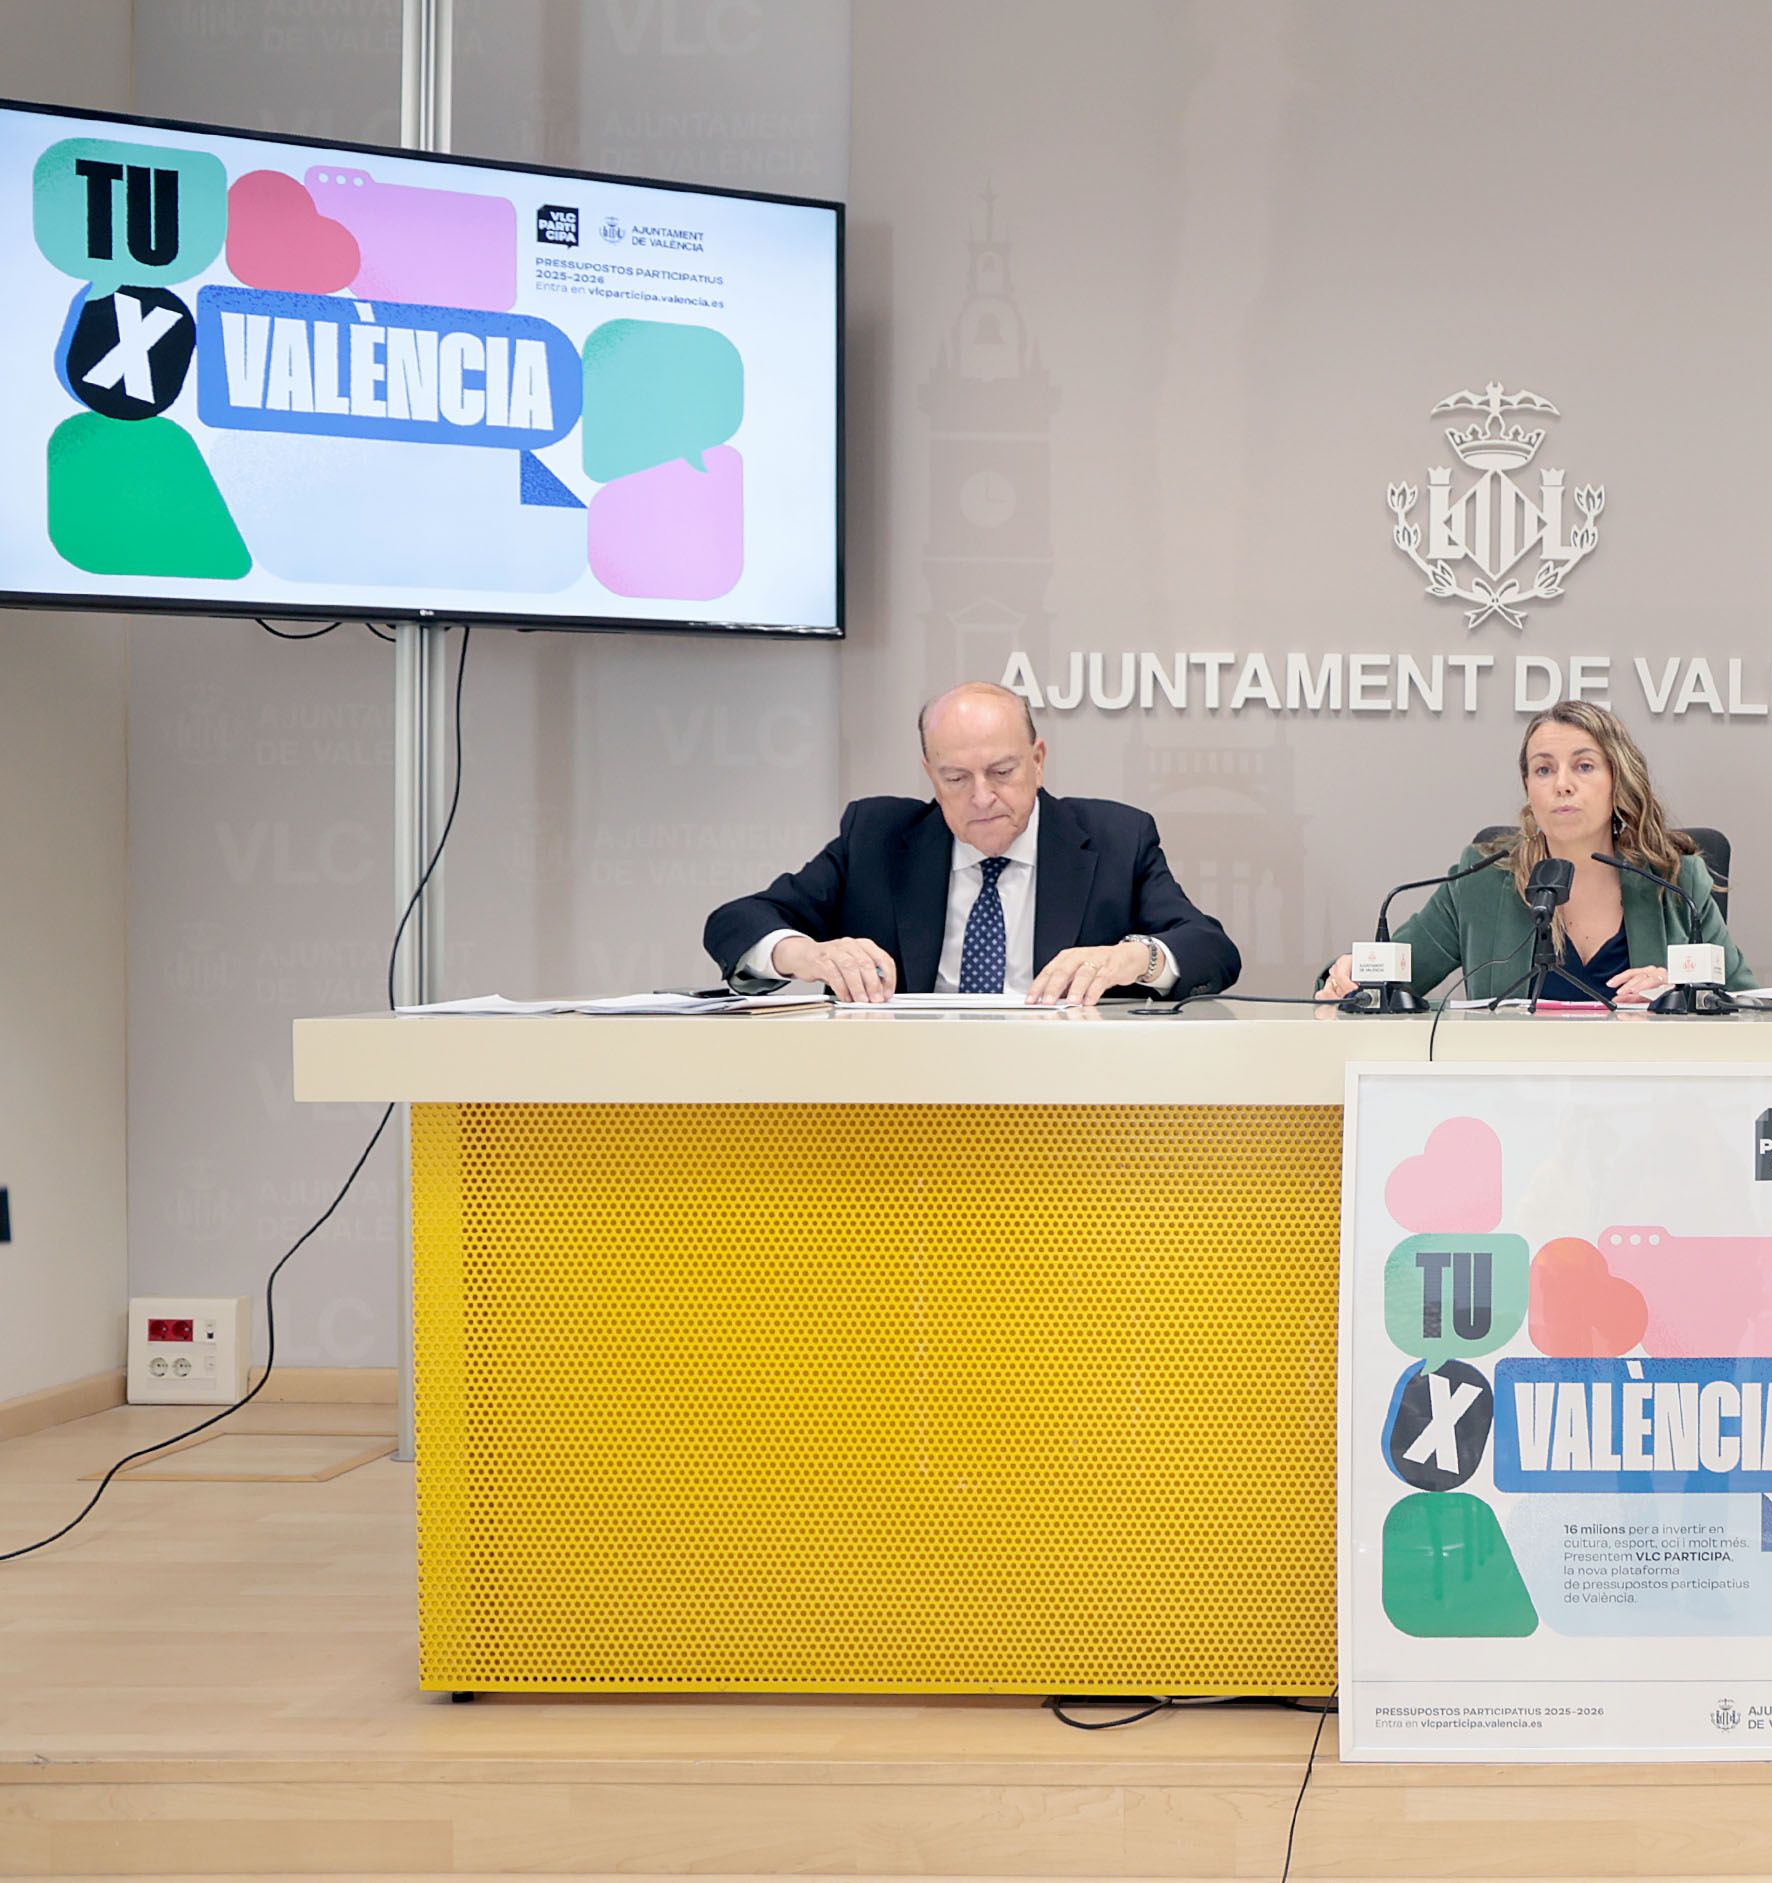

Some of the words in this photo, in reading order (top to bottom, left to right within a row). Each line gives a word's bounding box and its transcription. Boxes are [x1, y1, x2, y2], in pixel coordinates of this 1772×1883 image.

[76, 158, 180, 267] TU
[550, 211, 577, 223] VLC
[539, 219, 577, 233] PARTI
[632, 225, 704, 241] AJUNTAMENT
[545, 231, 577, 243] CIPA
[632, 236, 646, 246] DE
[536, 257, 634, 275] PRESSUPOSTOS
[636, 267, 724, 285] PARTICIPATIUS
[536, 281, 568, 293] Entra
[571, 286, 586, 295] en
[588, 286, 725, 309] vlcparticipa.valencia.es
[82, 291, 183, 404] X
[220, 297, 554, 432] VALÈNCIA
[1001, 651, 1494, 713] AJUNTAMENT
[1515, 656, 1612, 712] DE
[655, 704, 815, 769] VLC
[214, 819, 376, 885] VLC
[1415, 1252, 1493, 1341] TU
[1402, 1373, 1484, 1475] X
[1564, 1524, 1578, 1534] 16
[1580, 1523, 1626, 1534] milions
[1628, 1526, 1650, 1538] per
[1651, 1526, 1659, 1534] a
[1662, 1524, 1706, 1534] invertir
[1708, 1526, 1724, 1534] en
[1564, 1537, 1611, 1549] cultura,
[1614, 1538, 1658, 1552] esport,
[1661, 1538, 1680, 1548] oci
[1689, 1538, 1718, 1548] molt
[1720, 1537, 1750, 1548] més.
[1564, 1551, 1632, 1561] Presentem
[1636, 1551, 1661, 1561] VLC
[1664, 1551, 1734, 1562] PARTICIPA,
[1564, 1565, 1575, 1575] la
[1578, 1566, 1608, 1575] nova
[1611, 1565, 1680, 1578] plataforma
[1564, 1579, 1580, 1589] de
[1582, 1580, 1668, 1593] pressupostos
[1671, 1579, 1750, 1591] participatius
[1564, 1593, 1580, 1603] de
[1582, 1592, 1637, 1603] València.
[1375, 1707, 1461, 1716] PRESSUPOSTOS
[1463, 1707, 1542, 1716] PARTICIPATIUS
[1375, 1719, 1402, 1728] Entra
[1405, 1720, 1418, 1728] en
[1420, 1718, 1543, 1730] vlcparticipa.valencia.es
[1748, 1719, 1765, 1729] DE
